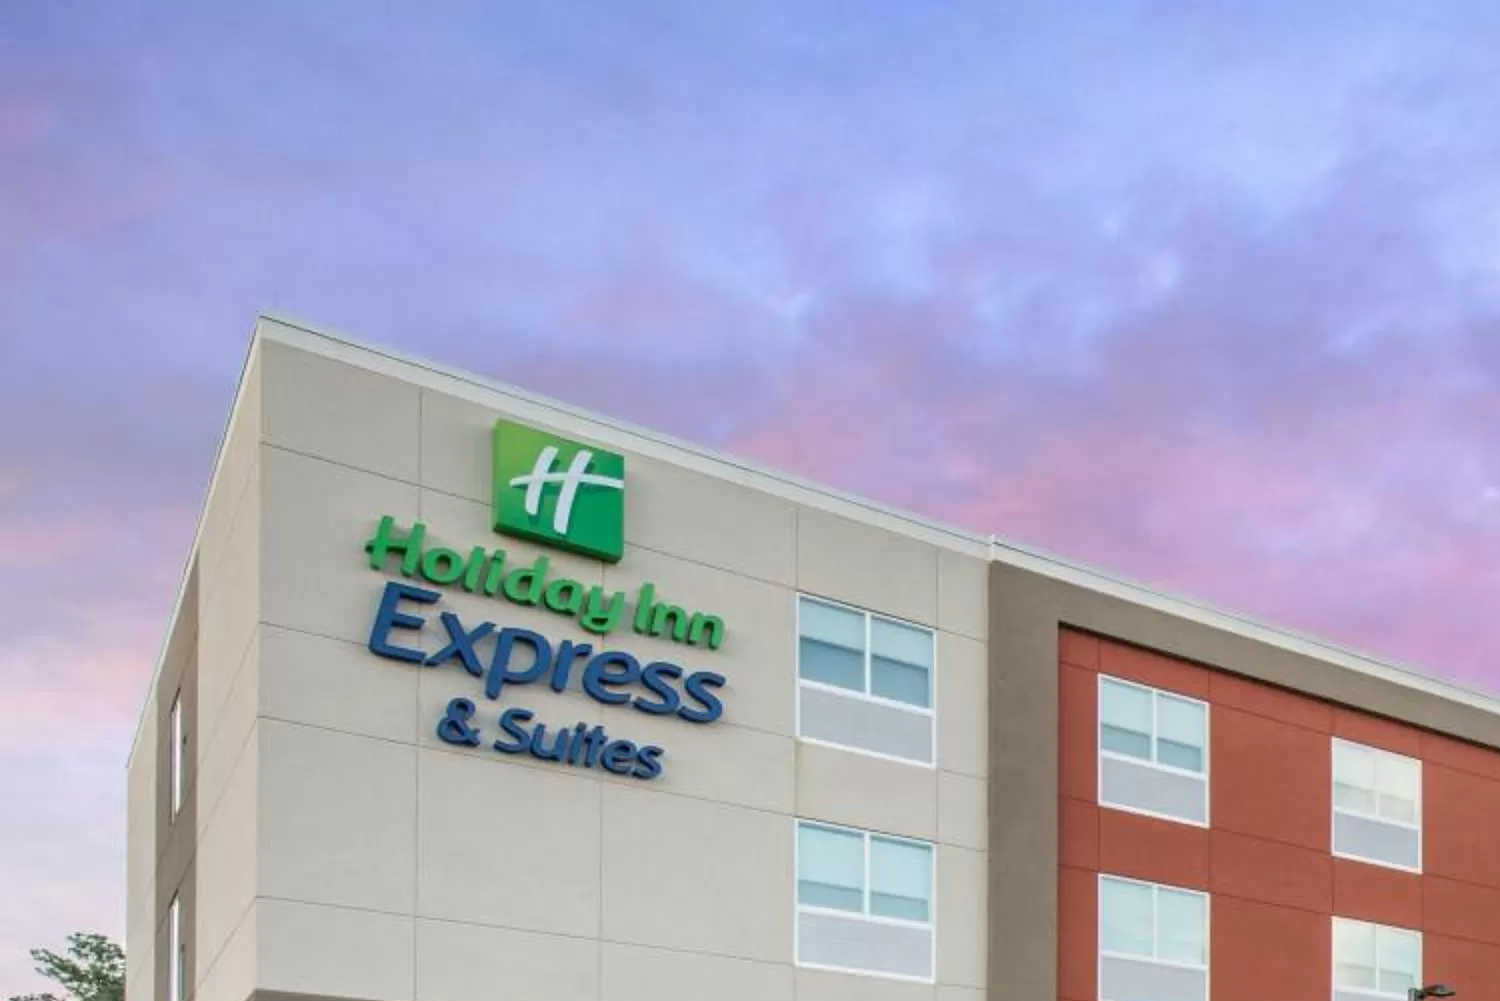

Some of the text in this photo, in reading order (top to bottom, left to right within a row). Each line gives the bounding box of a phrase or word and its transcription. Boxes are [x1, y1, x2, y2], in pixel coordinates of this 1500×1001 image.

[365, 515, 725, 650] Holiday Inn
[368, 580, 726, 723] Express
[436, 697, 665, 779] & Suites
